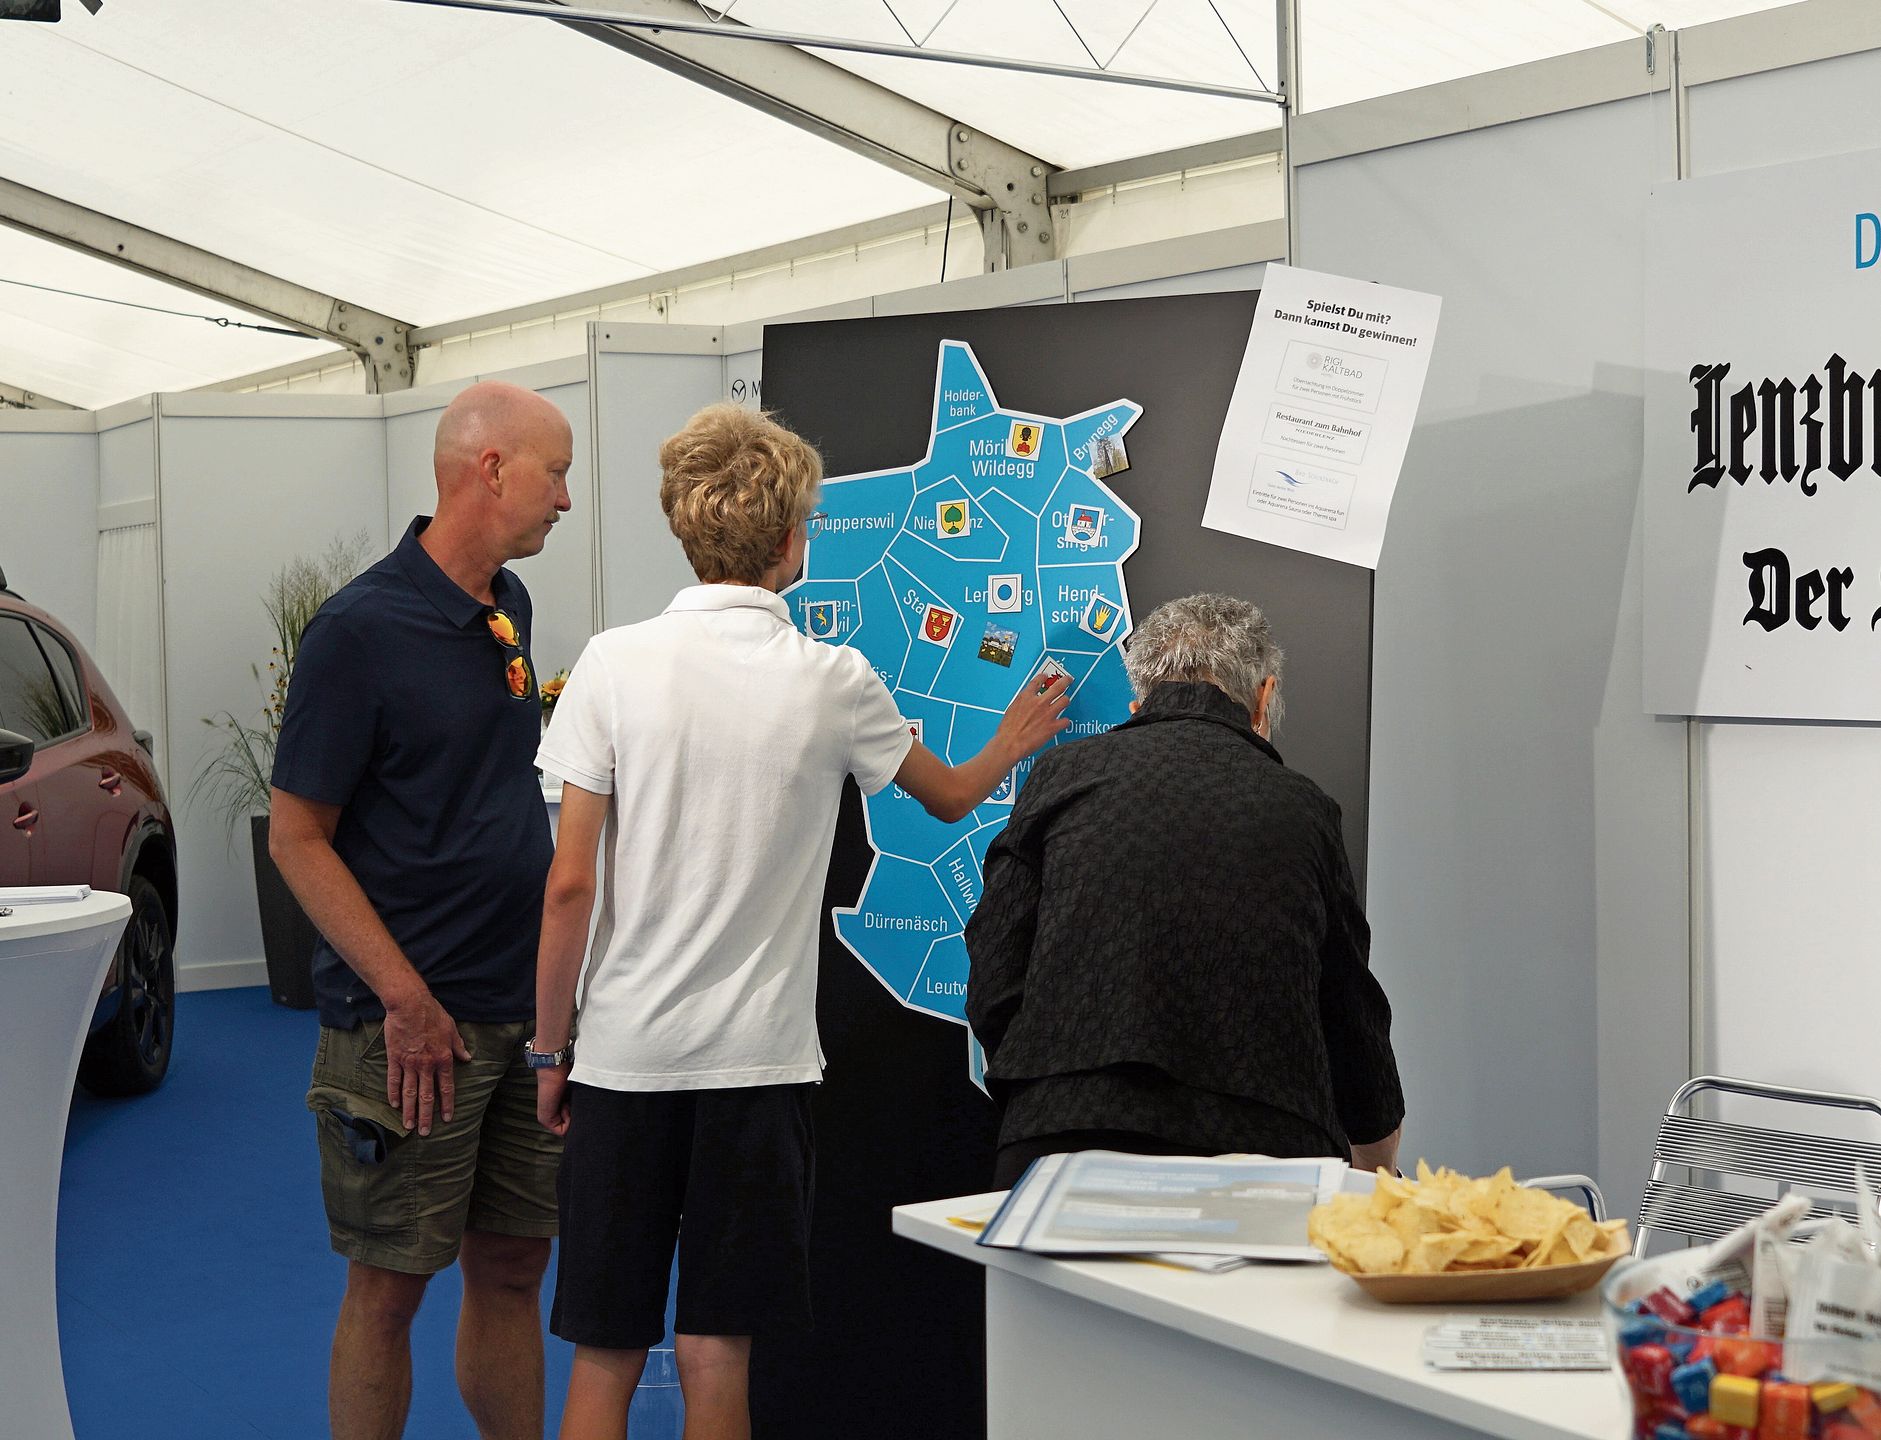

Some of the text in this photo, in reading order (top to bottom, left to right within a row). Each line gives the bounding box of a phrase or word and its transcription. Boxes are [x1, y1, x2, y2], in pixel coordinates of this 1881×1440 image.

[1306, 299, 1392, 325] Spielst Du mit?
[1274, 309, 1418, 347] Dann kannst Du gewinnen!
[1324, 356, 1343, 366] RIGI
[1322, 364, 1363, 379] KALTBAD
[944, 389, 984, 402] Holder-
[950, 404, 976, 417] bank
[1276, 412, 1362, 438] Restaurant zum Bahnhof
[970, 438, 1007, 456] Möri
[972, 460, 1035, 479] Wildegg
[1742, 547, 1854, 632] Der
[865, 912, 948, 932] Dürrenäsch
[926, 977, 967, 995] Leutw
